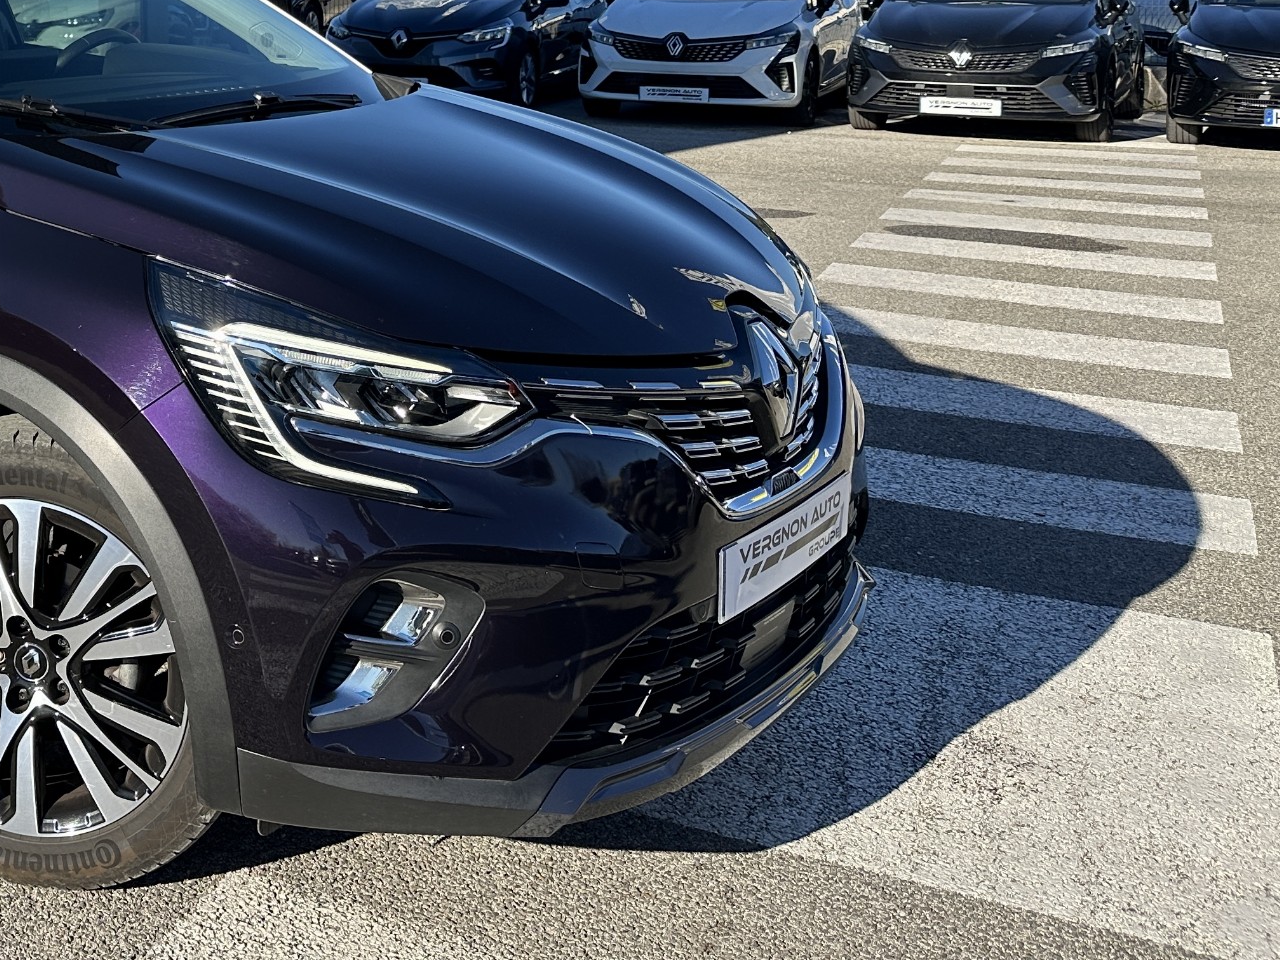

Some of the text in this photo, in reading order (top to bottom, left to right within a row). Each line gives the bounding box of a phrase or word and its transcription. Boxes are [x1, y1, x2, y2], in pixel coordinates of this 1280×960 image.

[739, 490, 841, 564] VERGNON AUTO
[808, 527, 841, 557] GROUPE
